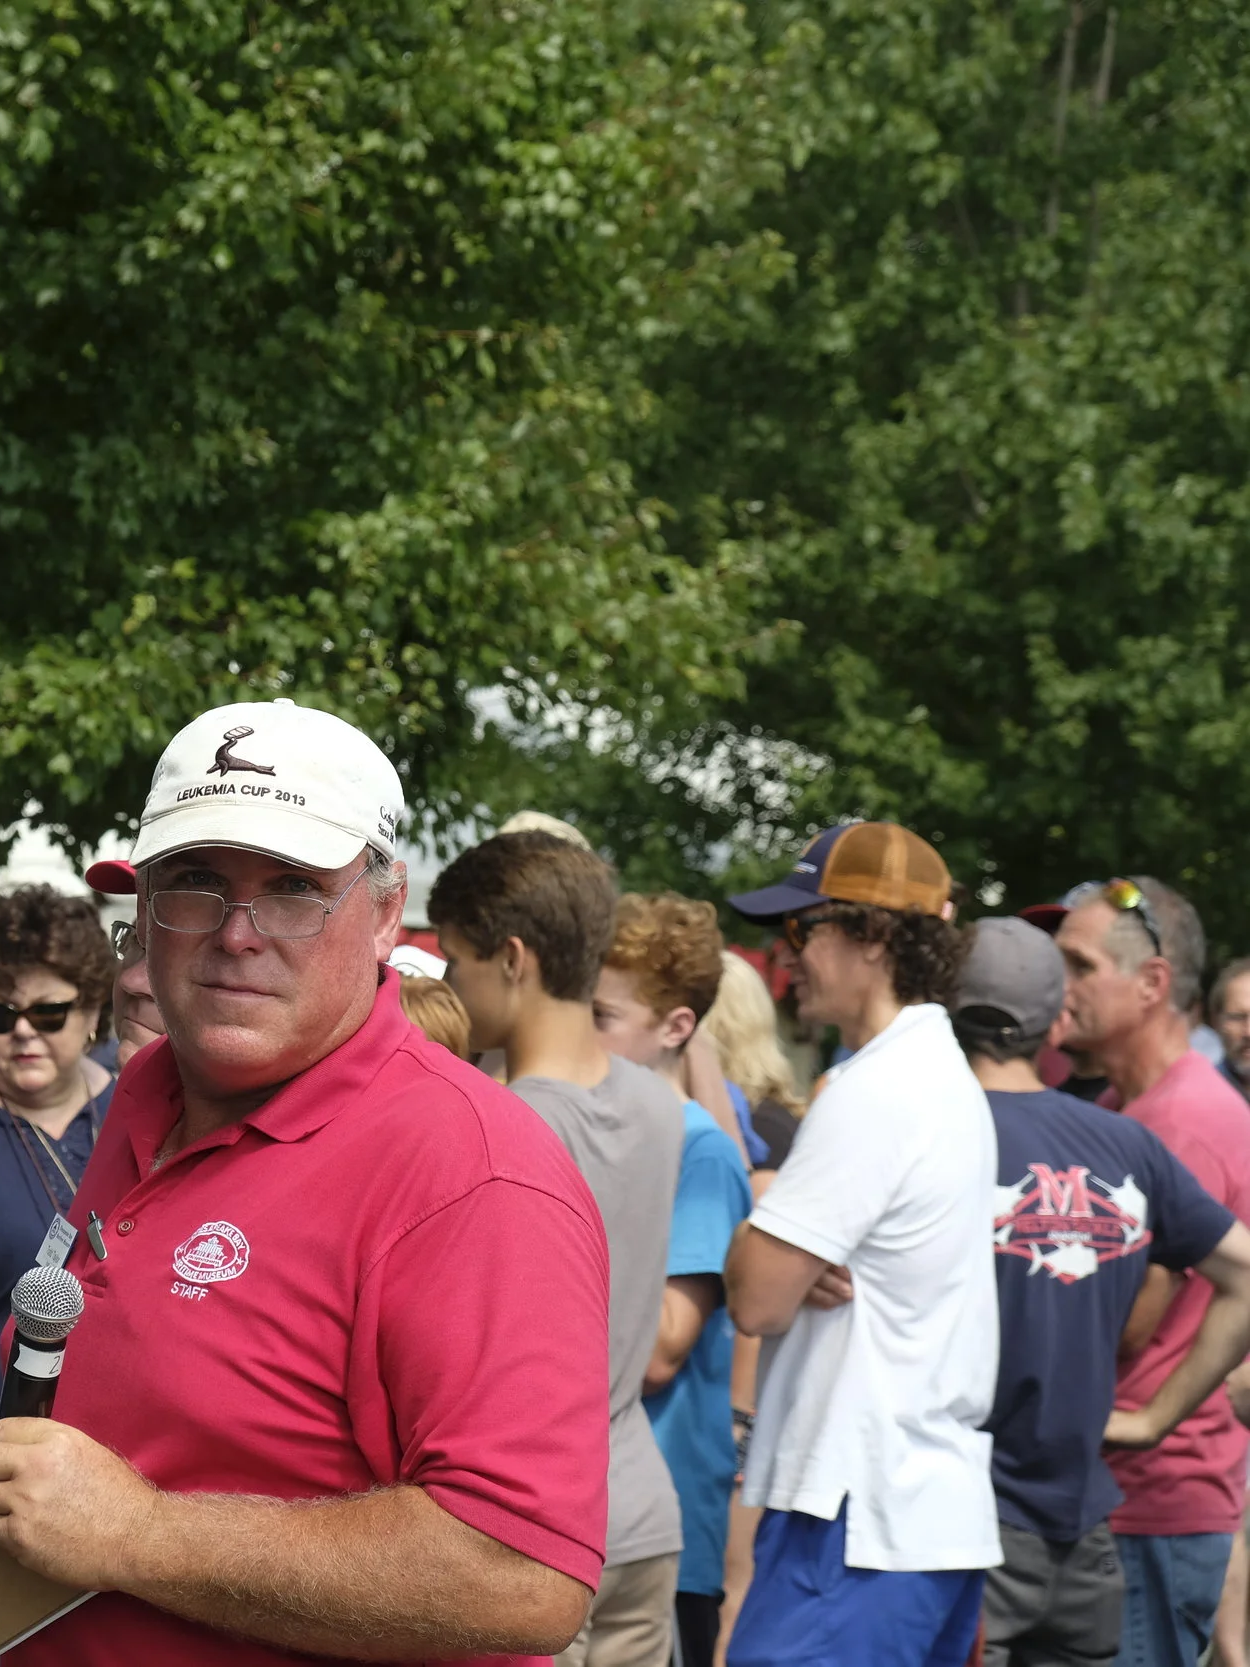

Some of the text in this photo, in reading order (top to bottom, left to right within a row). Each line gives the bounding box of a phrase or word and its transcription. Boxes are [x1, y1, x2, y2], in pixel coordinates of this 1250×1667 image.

[176, 784, 306, 807] LEUKEMIA CUP 2013
[1027, 1162, 1095, 1218] M
[232, 1233, 245, 1250] BAY
[198, 1265, 237, 1280] MUSEUM
[171, 1281, 208, 1301] STAFF
[49, 1355, 61, 1375] 2
